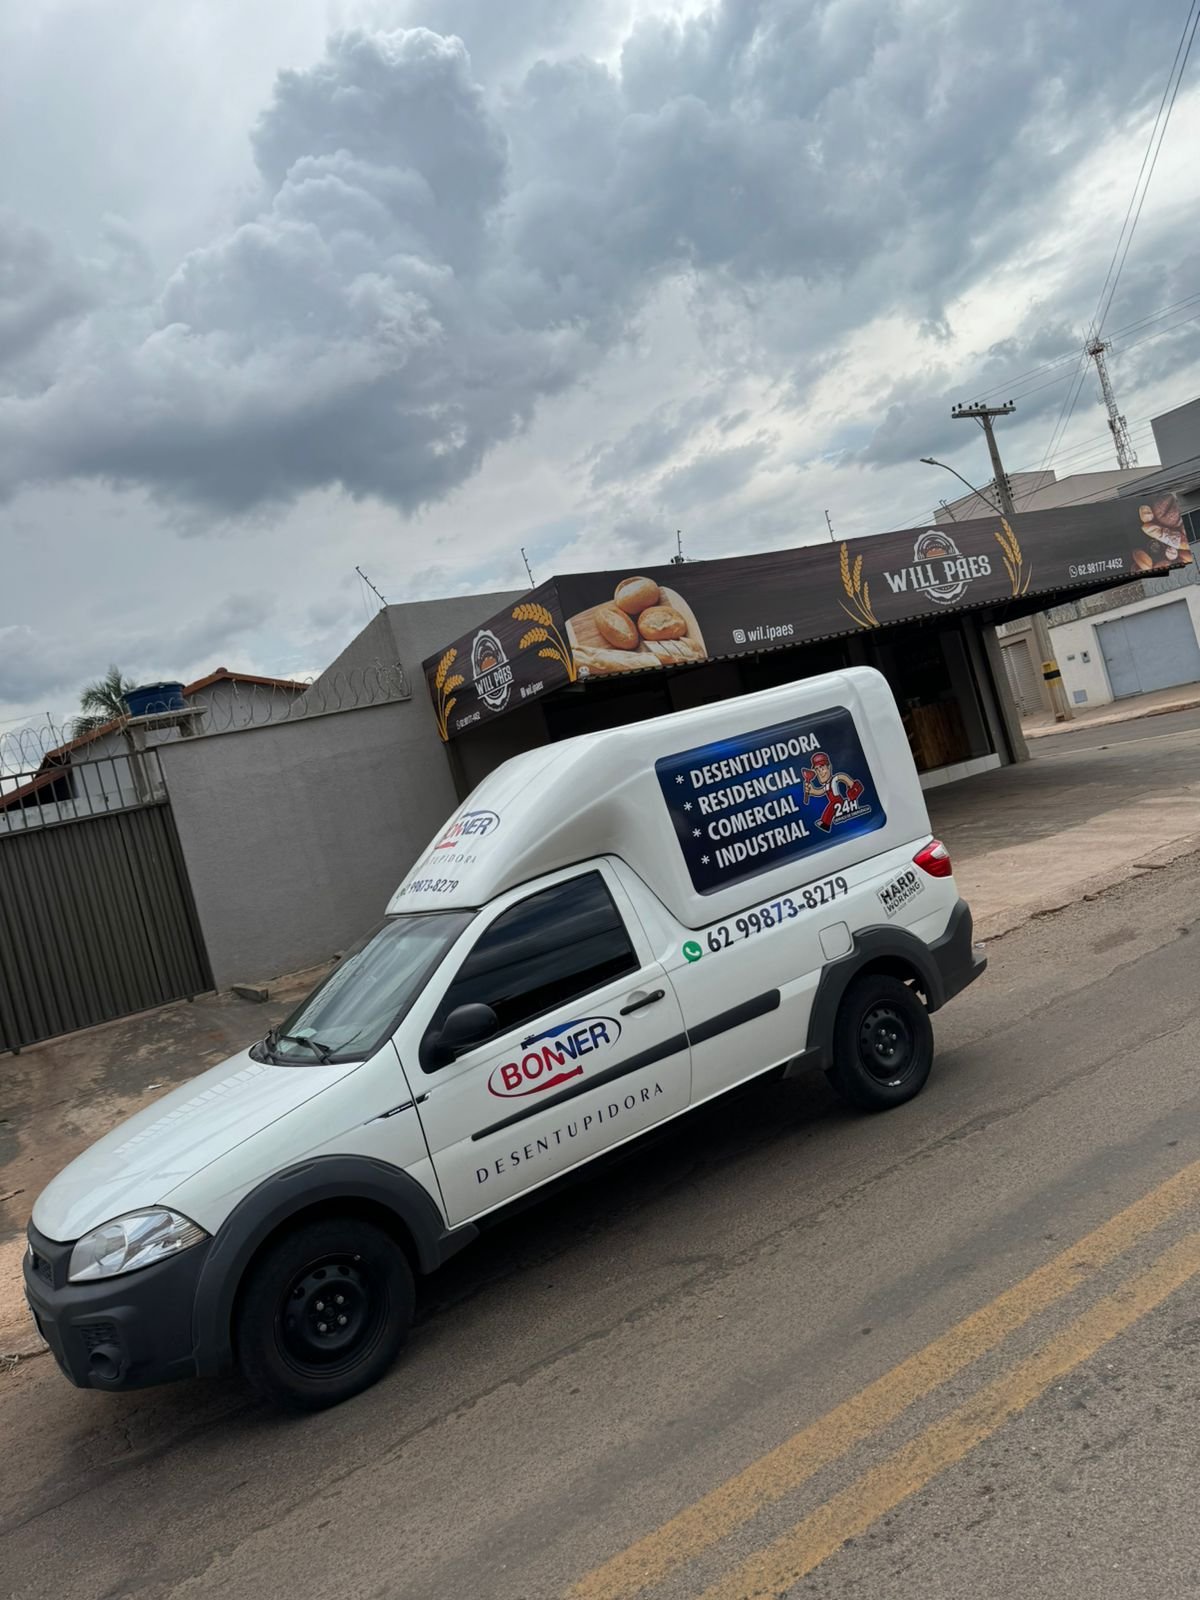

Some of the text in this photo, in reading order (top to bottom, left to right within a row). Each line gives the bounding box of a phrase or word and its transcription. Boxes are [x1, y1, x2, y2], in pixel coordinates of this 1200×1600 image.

[883, 563, 940, 593] WILL
[748, 624, 794, 641] wil.ipaes
[475, 679, 494, 695] WILL
[689, 732, 821, 789] DESENTUPIDORA
[698, 767, 801, 815] RESIDENCIAL
[834, 799, 858, 817] 24H
[707, 795, 800, 841] COMERCIAL
[715, 819, 810, 869] INDUSTRIAL
[880, 871, 915, 905] HARD
[886, 881, 920, 912] WORKING
[707, 876, 849, 952] 62 99873-8279
[501, 1022, 611, 1091] BONNER
[476, 1083, 664, 1184] DESENTUPIDORA
